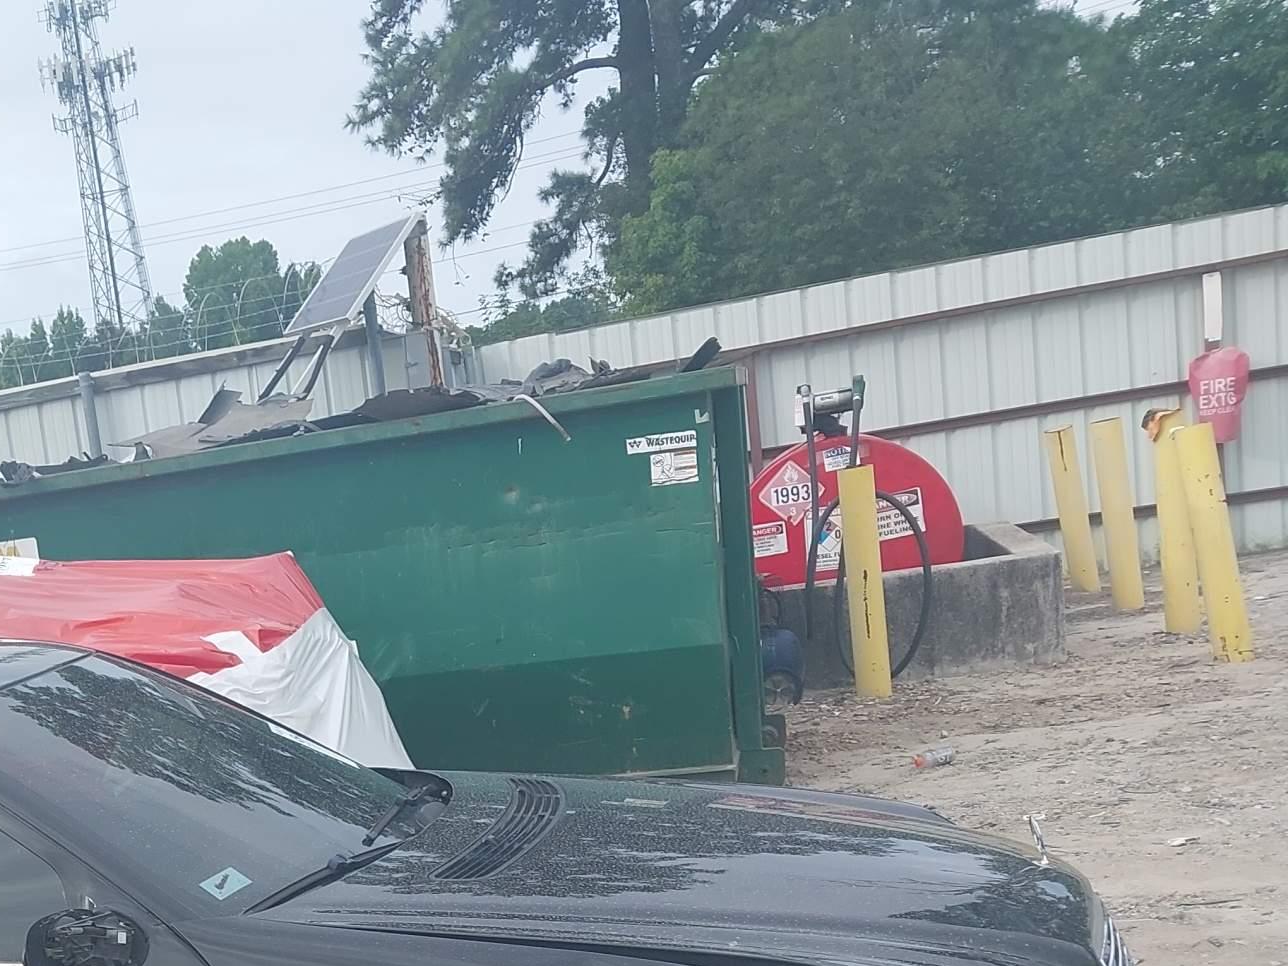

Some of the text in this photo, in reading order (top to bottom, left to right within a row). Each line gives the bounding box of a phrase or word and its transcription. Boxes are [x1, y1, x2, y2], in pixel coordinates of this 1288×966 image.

[1199, 377, 1236, 395] FIRE
[1199, 392, 1237, 409] EXTG
[645, 433, 696, 447] WASTEQUIP
[773, 484, 810, 505] 1993
[790, 507, 797, 516] 3
[752, 527, 777, 536] ANGER
[825, 522, 832, 532] 2
[834, 529, 841, 539] 0
